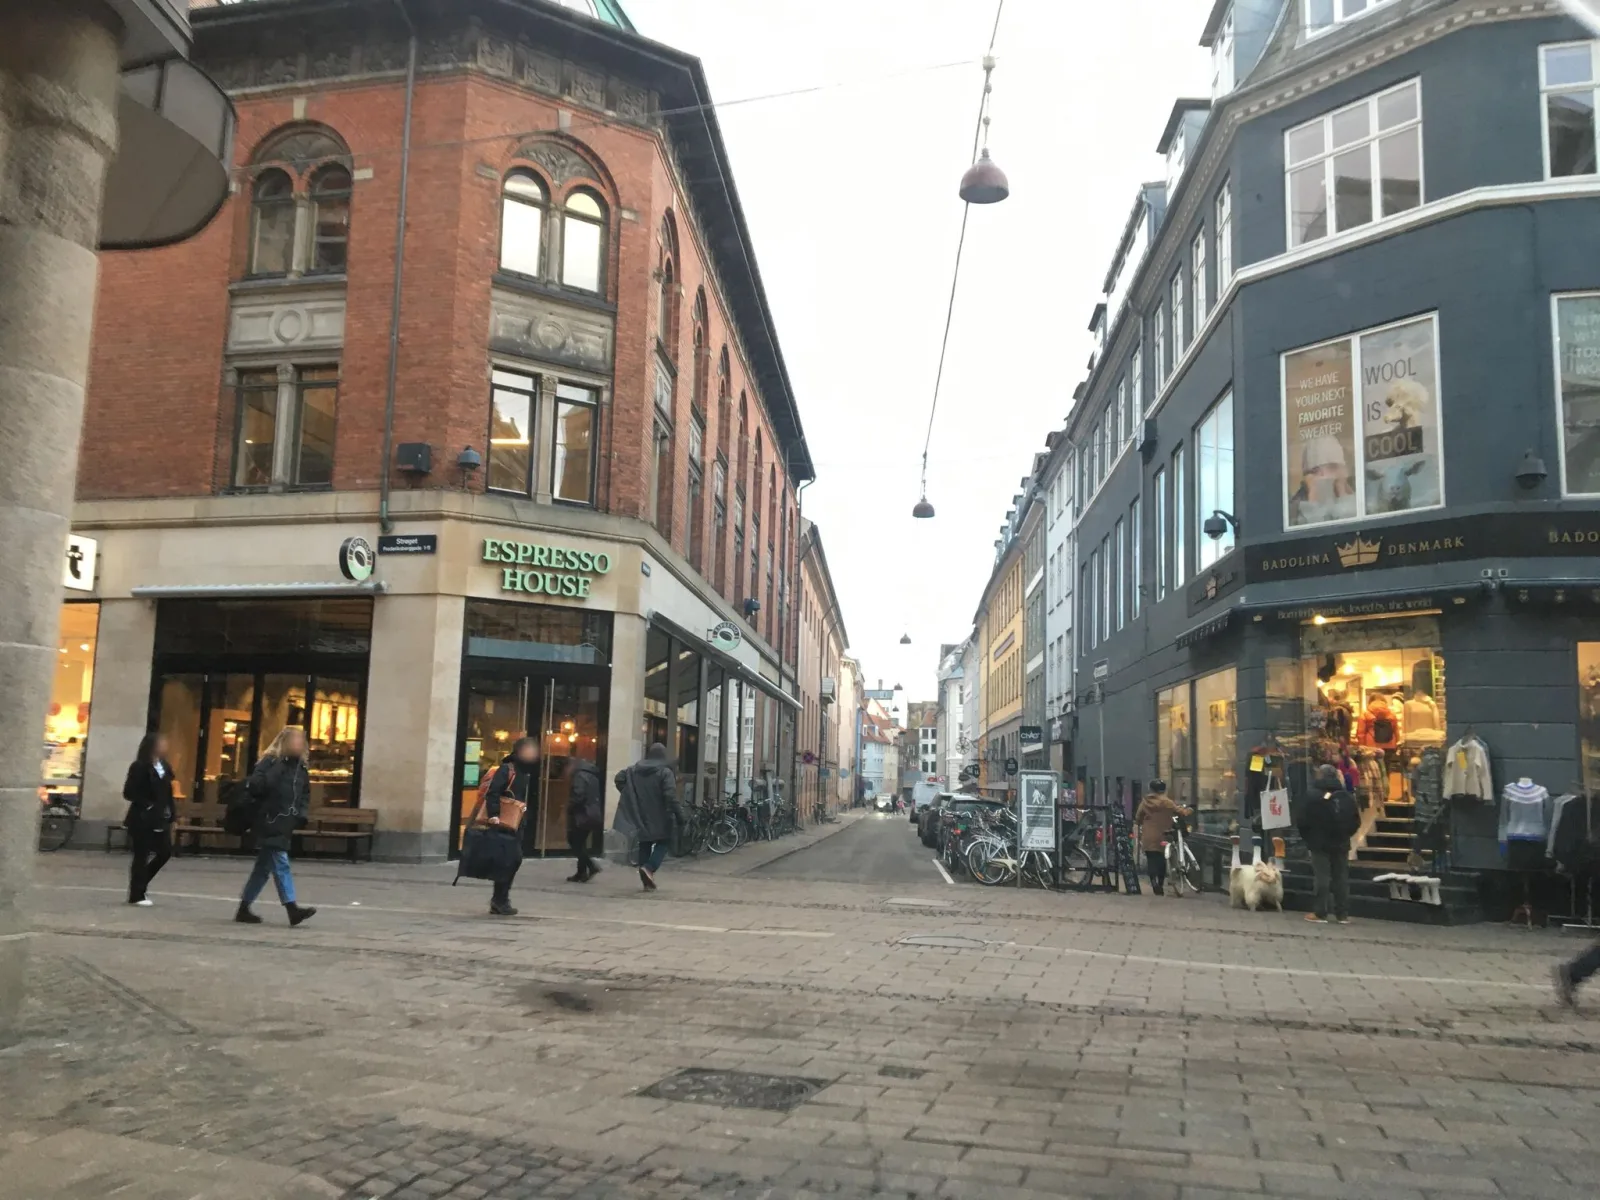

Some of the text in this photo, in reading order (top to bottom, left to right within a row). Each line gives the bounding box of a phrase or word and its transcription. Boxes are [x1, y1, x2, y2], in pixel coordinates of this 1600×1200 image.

[1300, 371, 1340, 390] WE HAVE
[1365, 357, 1417, 385] WOOL
[1295, 386, 1346, 408] YOUR NEXT
[1298, 404, 1345, 424] FAVORITE
[1366, 400, 1382, 421] IS
[1299, 422, 1343, 440] SWEATER
[1367, 431, 1418, 458] COOL
[482, 537, 612, 575] ESPRESSO
[1262, 535, 1465, 571] BADOLINA DENMARK
[502, 567, 593, 599] HOUSE
